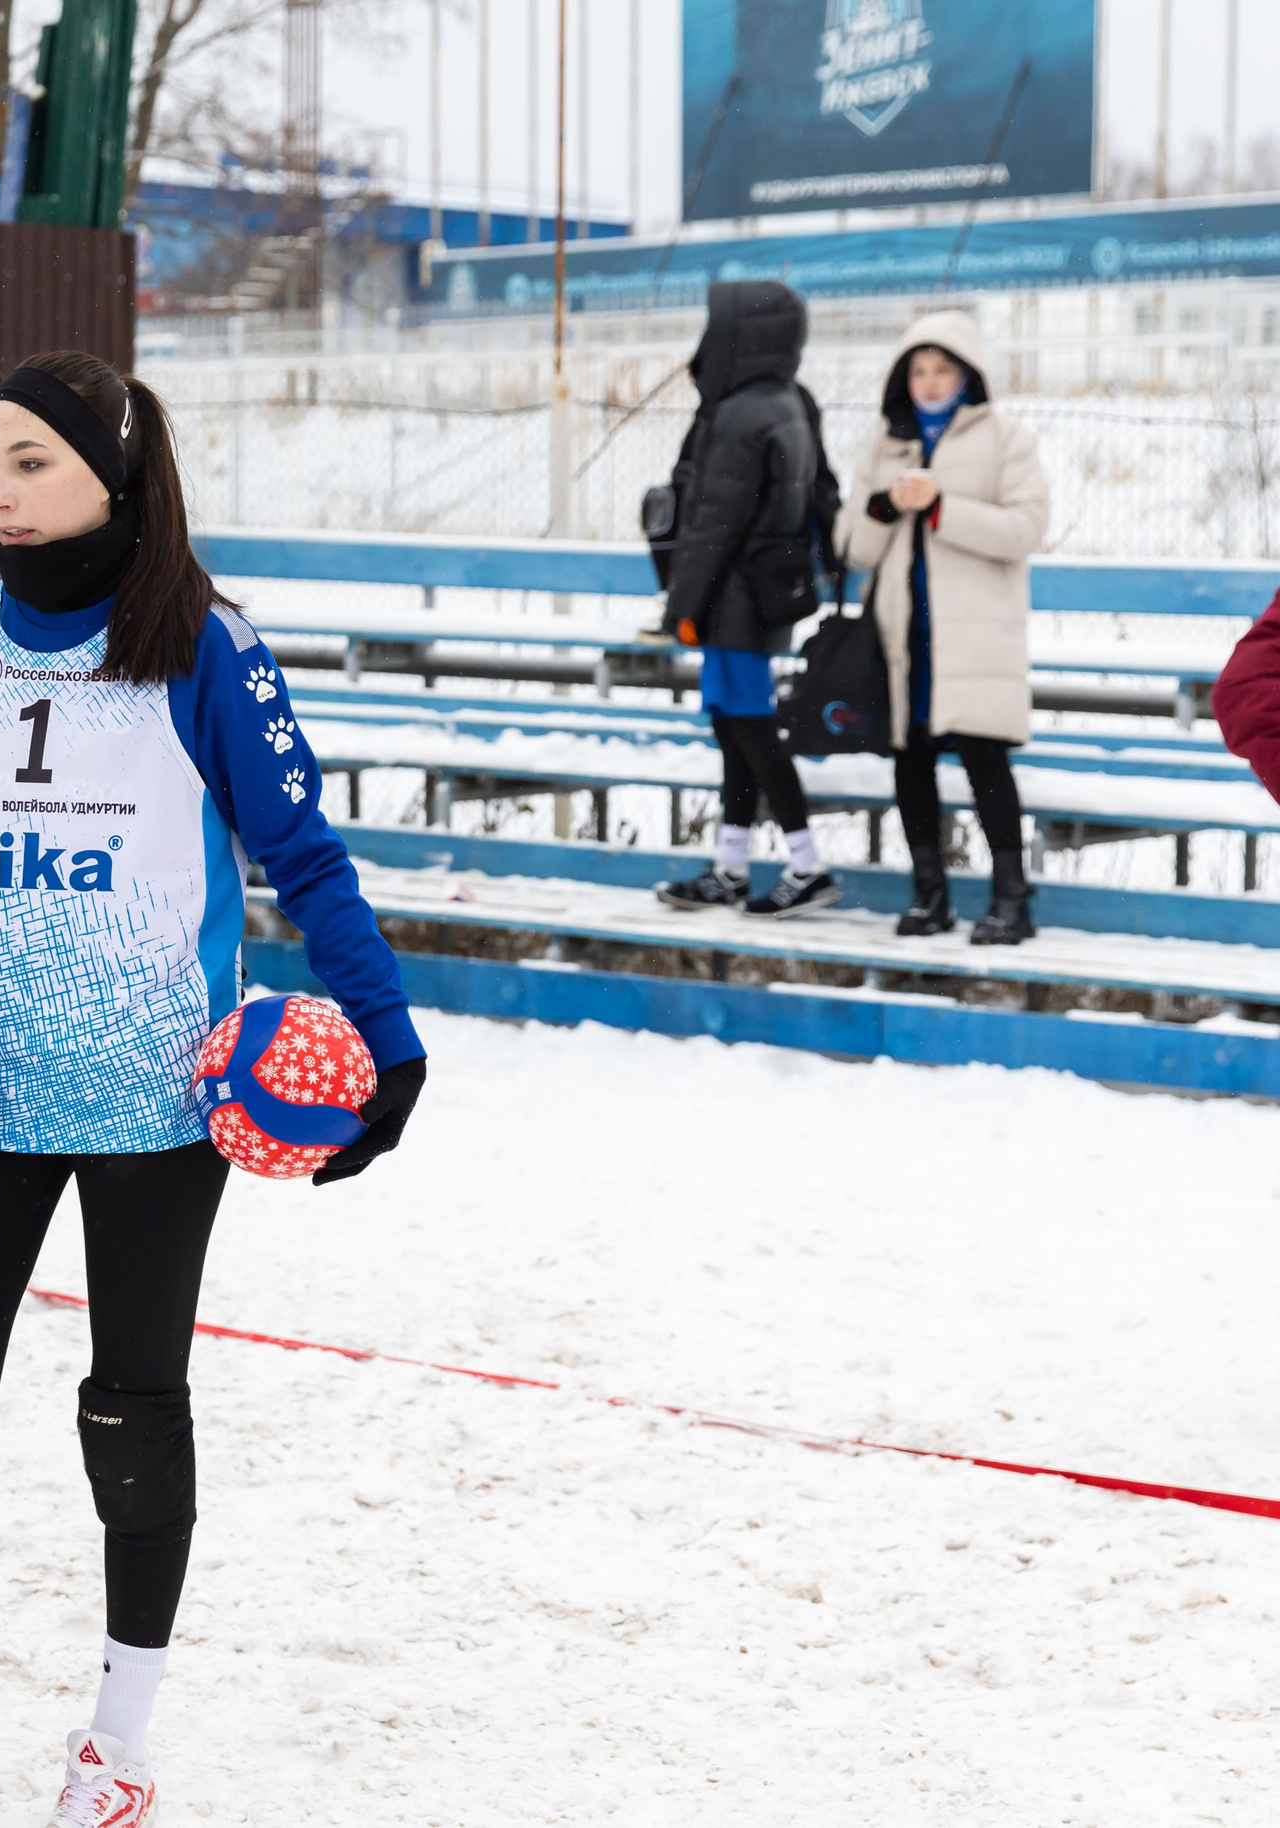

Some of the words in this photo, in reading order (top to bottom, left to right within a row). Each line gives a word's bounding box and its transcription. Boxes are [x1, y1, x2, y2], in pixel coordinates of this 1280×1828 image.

[258, 689, 274, 699] KELME
[15, 699, 53, 784] 1
[276, 741, 291, 751] KELME
[2, 799, 68, 815] ВОЛЕЙБОЛА
[71, 803, 136, 816] УДМУРТИИ
[86, 1412, 123, 1425] Larsen
